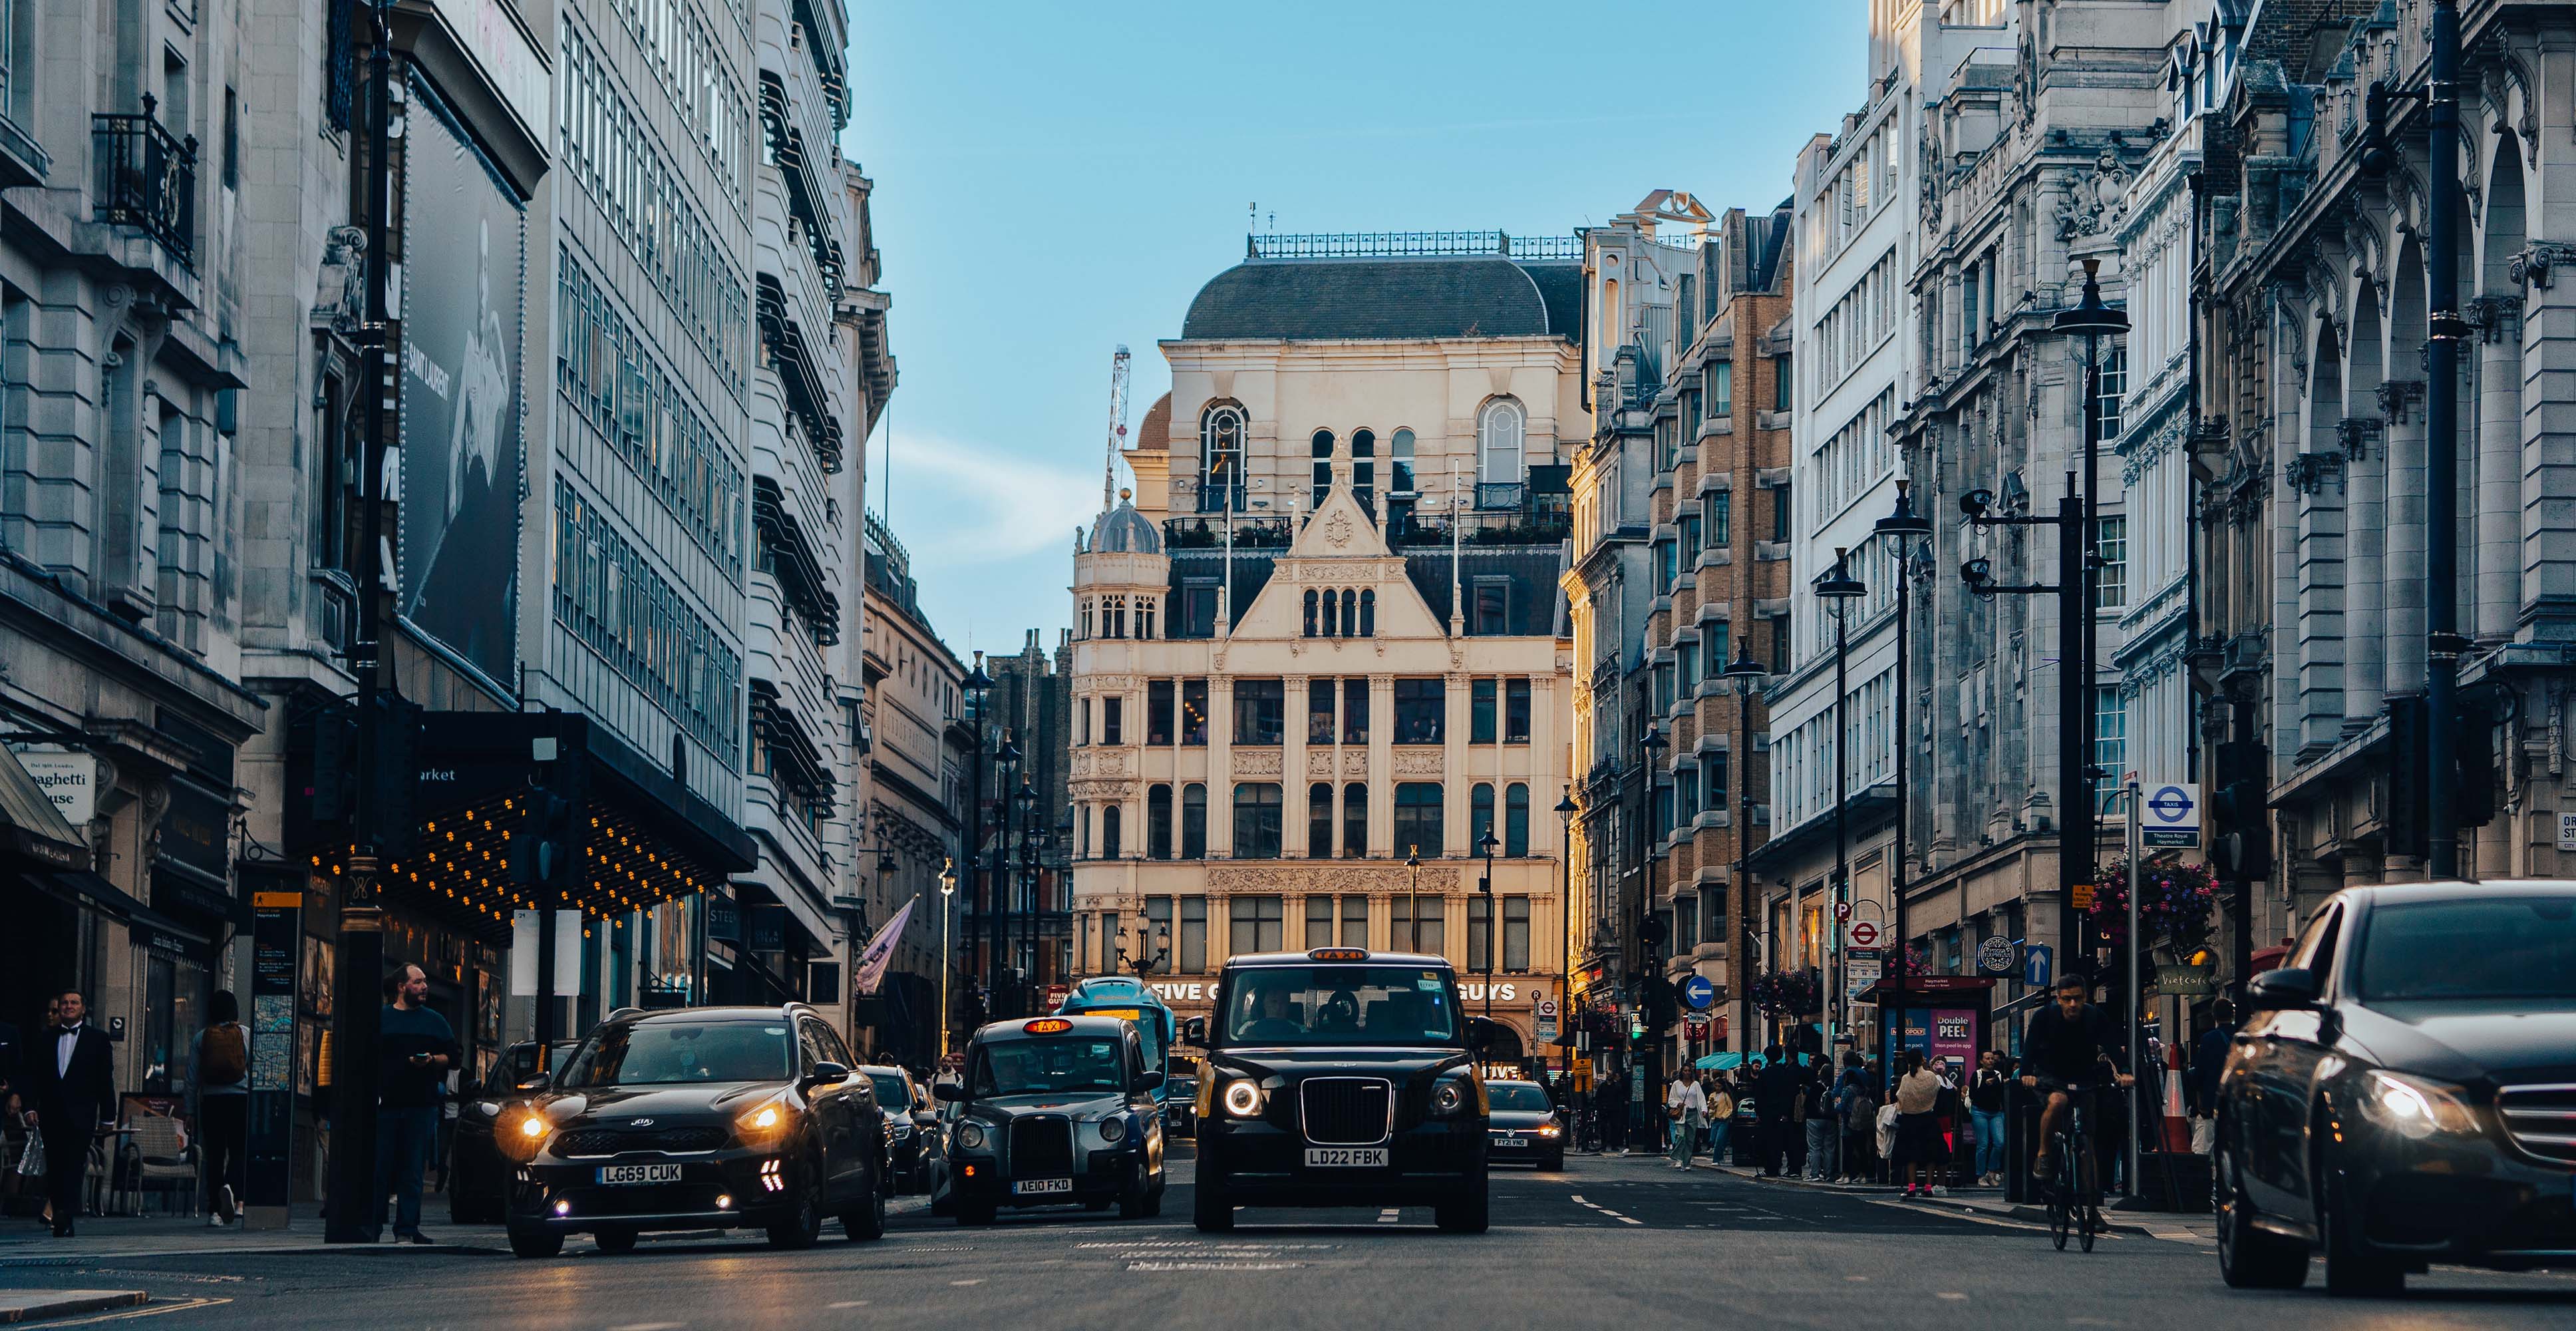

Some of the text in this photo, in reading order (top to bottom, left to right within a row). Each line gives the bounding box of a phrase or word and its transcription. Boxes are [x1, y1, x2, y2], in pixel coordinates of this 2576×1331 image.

[408, 341, 450, 401] SAINT LAURENT
[420, 768, 455, 781] arket
[49, 795, 74, 804] use
[1838, 904, 1848, 917] P
[1319, 950, 1359, 959] TAXI
[1457, 983, 1516, 1001] GUYS
[1035, 1021, 1062, 1031] TAXI
[1939, 1026, 1967, 1038] PEEL
[1309, 1150, 1382, 1165] LD22 FBK
[605, 1165, 680, 1183] LG69 CUK
[1021, 1179, 1068, 1192] AE10 FKD
